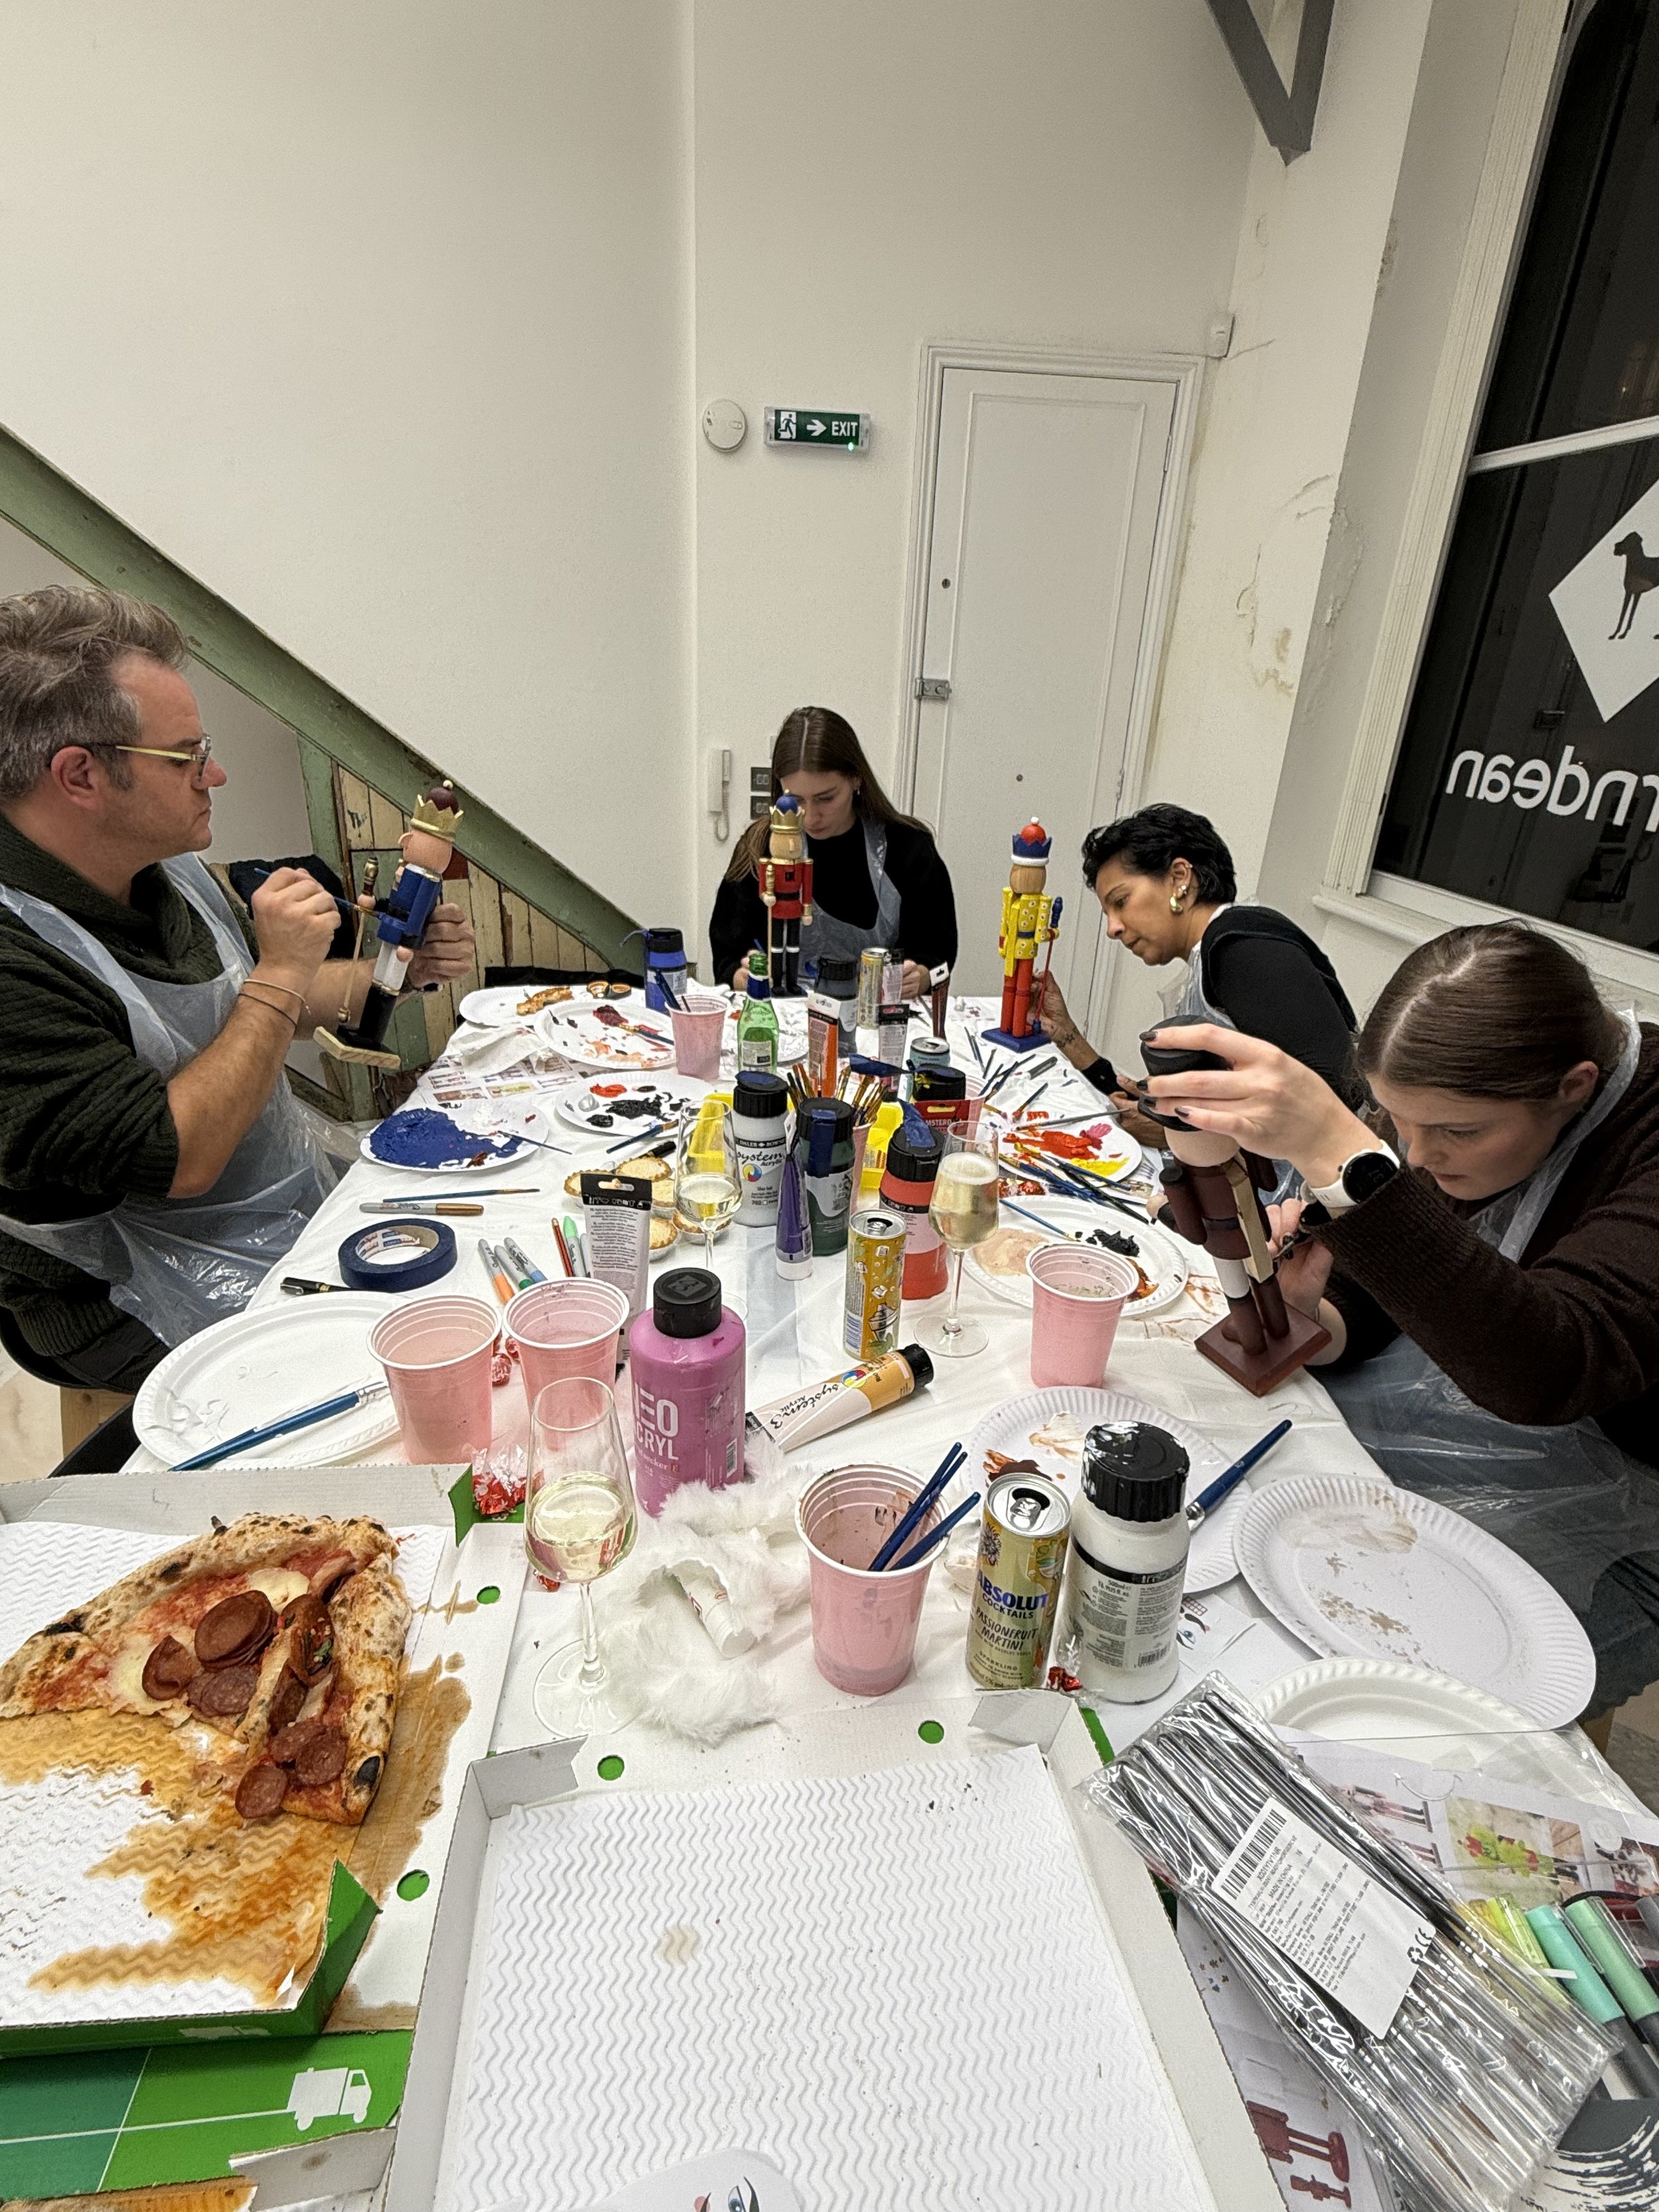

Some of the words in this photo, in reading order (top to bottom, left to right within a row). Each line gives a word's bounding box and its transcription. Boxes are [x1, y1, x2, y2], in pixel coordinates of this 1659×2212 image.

[831, 421, 858, 437] EXIT
[780, 1395, 806, 1413] Acrylic
[782, 1384, 839, 1418] system
[636, 1420, 679, 1460] CRYL
[977, 1570, 1050, 1610] ABSOLUT
[982, 1593, 1034, 1619] COCKTAILS
[975, 1606, 1039, 1639] PASSIONFRUIT
[981, 1627, 1024, 1651] MARTINI
[979, 1651, 1018, 1670] SPARKLING
